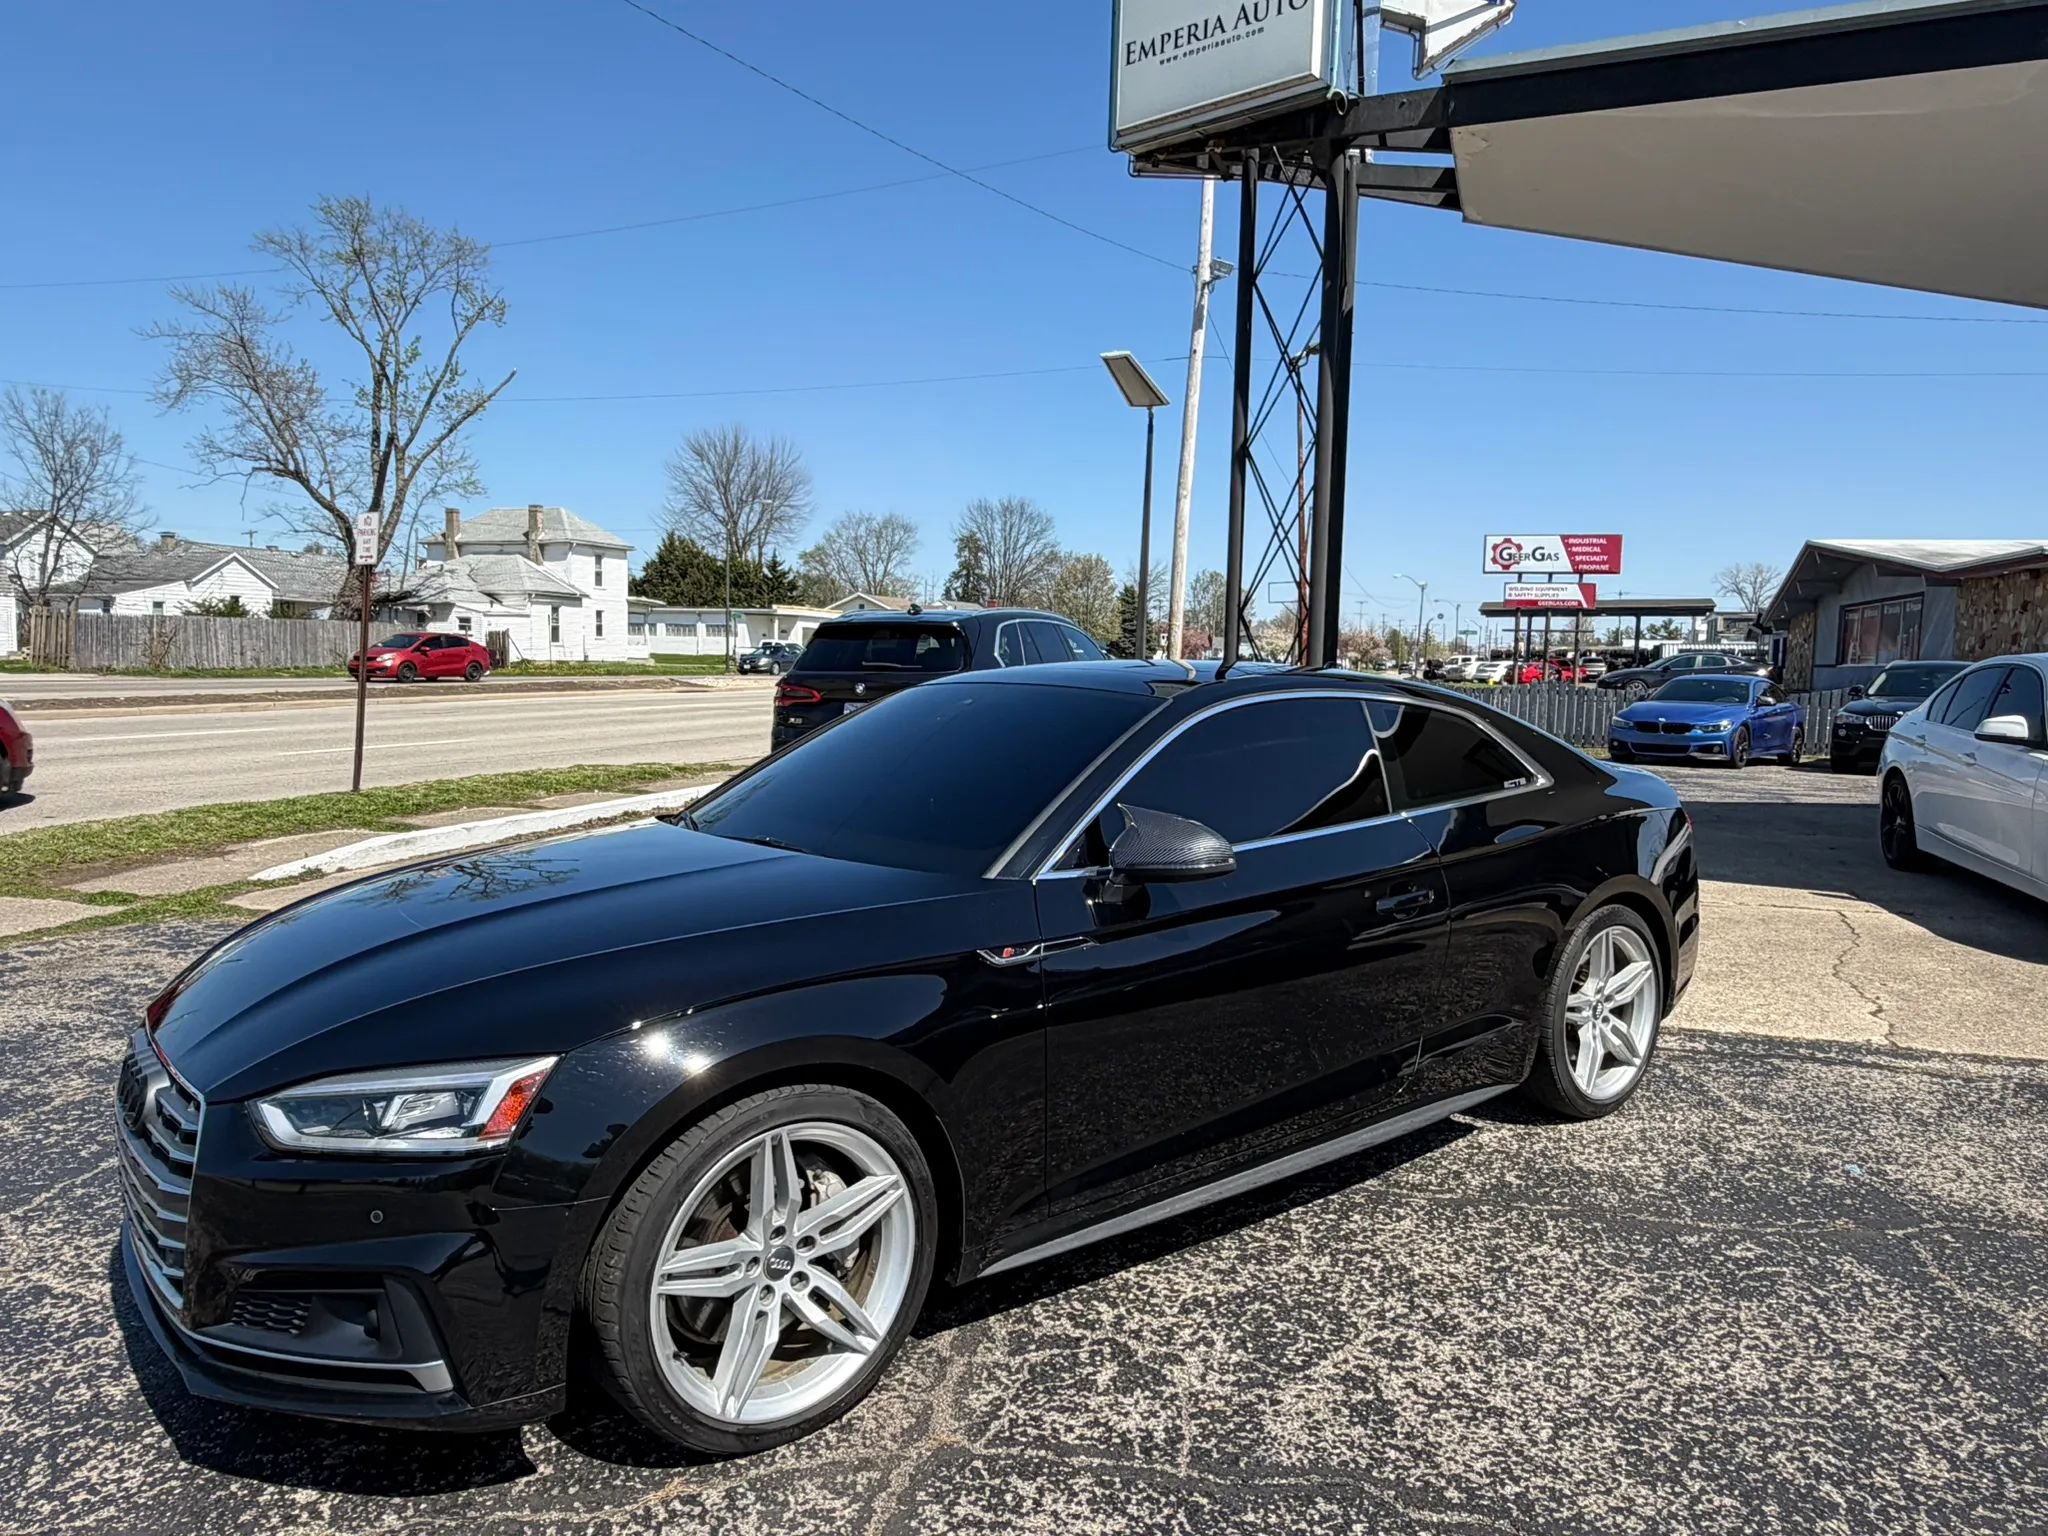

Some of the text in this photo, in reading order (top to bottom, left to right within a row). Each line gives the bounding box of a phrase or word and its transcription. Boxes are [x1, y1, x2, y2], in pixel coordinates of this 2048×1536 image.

[1125, 14, 1226, 67] EMPERIA
[1159, 26, 1265, 66] www.emperiaauto.com
[357, 528, 377, 536] PARKING
